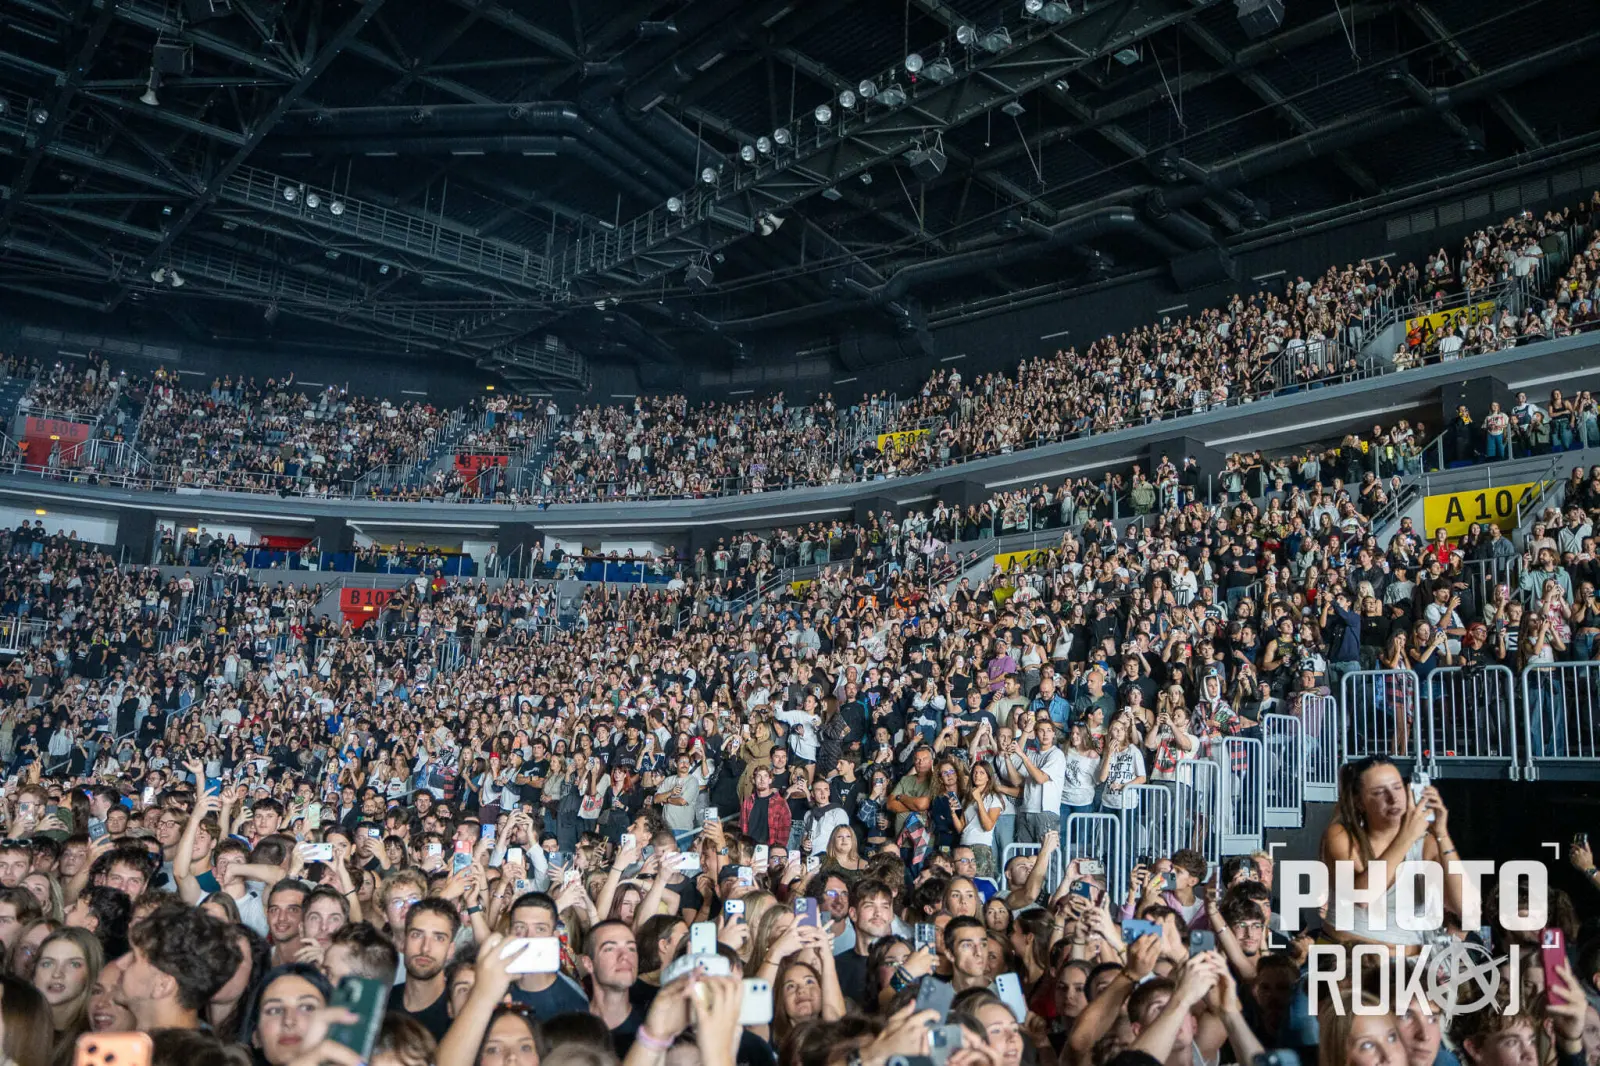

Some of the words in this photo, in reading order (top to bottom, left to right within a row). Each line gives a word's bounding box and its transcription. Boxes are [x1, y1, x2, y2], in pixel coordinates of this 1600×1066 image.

[36, 419, 45, 432] B
[1445, 496, 1466, 524] A
[351, 590, 360, 604] B
